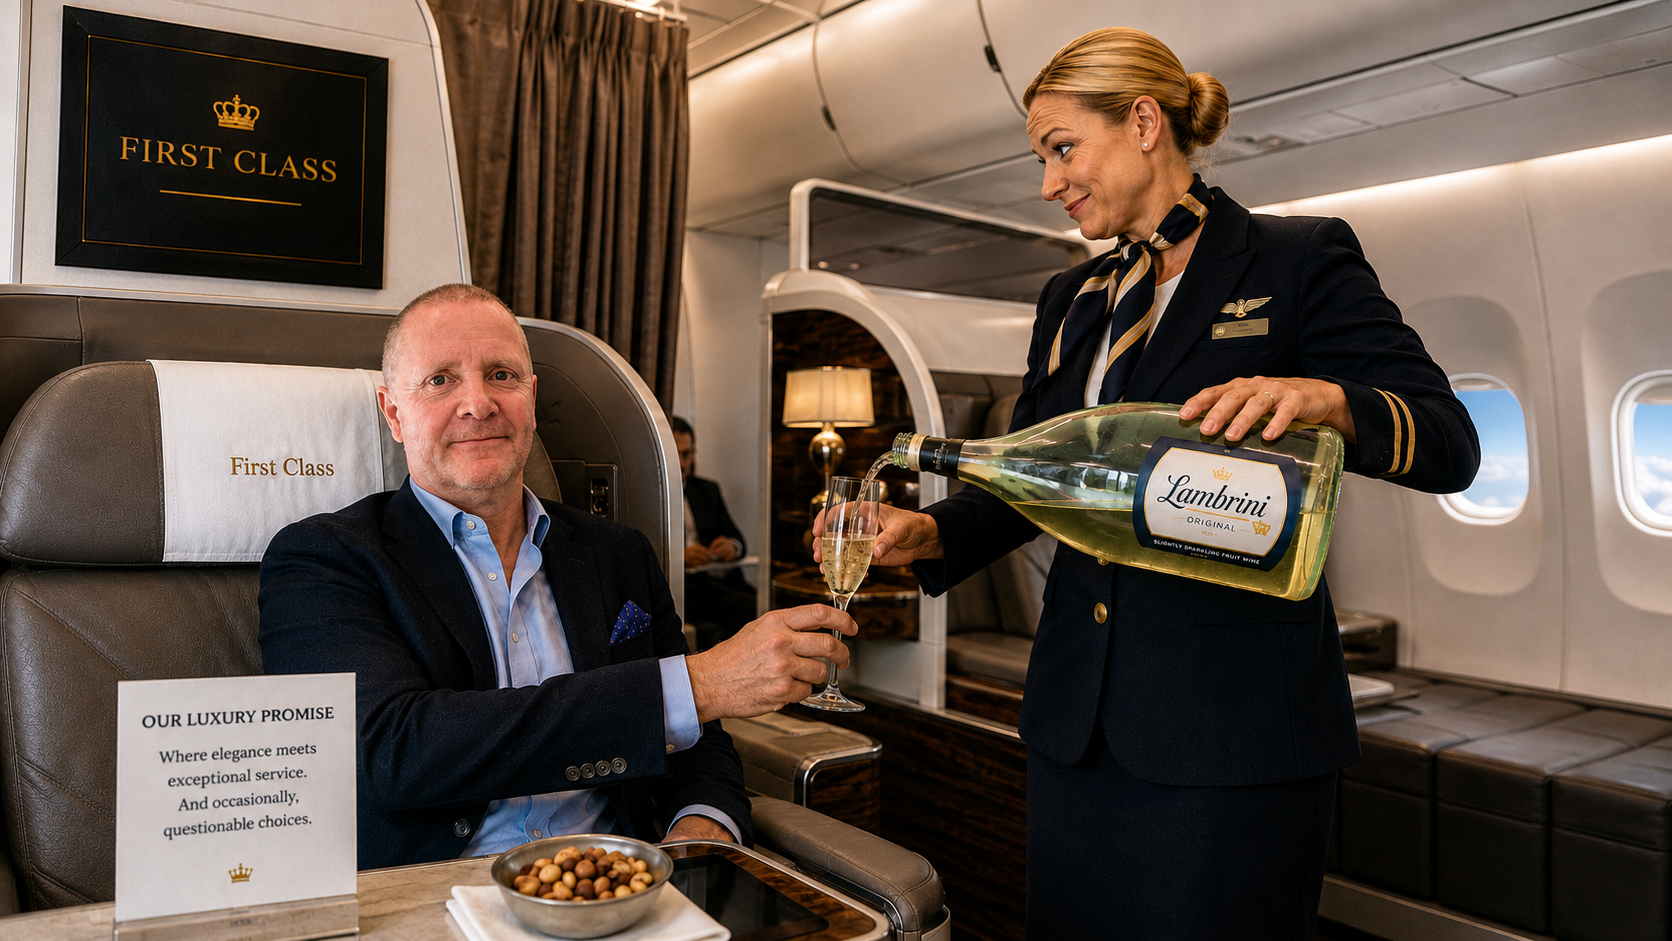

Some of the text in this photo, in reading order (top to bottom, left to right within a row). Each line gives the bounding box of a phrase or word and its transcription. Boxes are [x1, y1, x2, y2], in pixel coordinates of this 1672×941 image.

[119, 136, 338, 183] FIRST CLASS
[229, 456, 335, 477] First Class
[1156, 474, 1271, 518] Lambrini
[1186, 516, 1236, 533] ORIGINAL
[141, 706, 335, 729] OUR LUXURY PROMISE
[159, 749, 208, 764] Where
[211, 747, 272, 763] elegance
[275, 743, 317, 757] meets
[167, 767, 308, 789] exceptional service.
[177, 789, 300, 812] And occasionally,
[163, 813, 313, 841] questionable choices.
